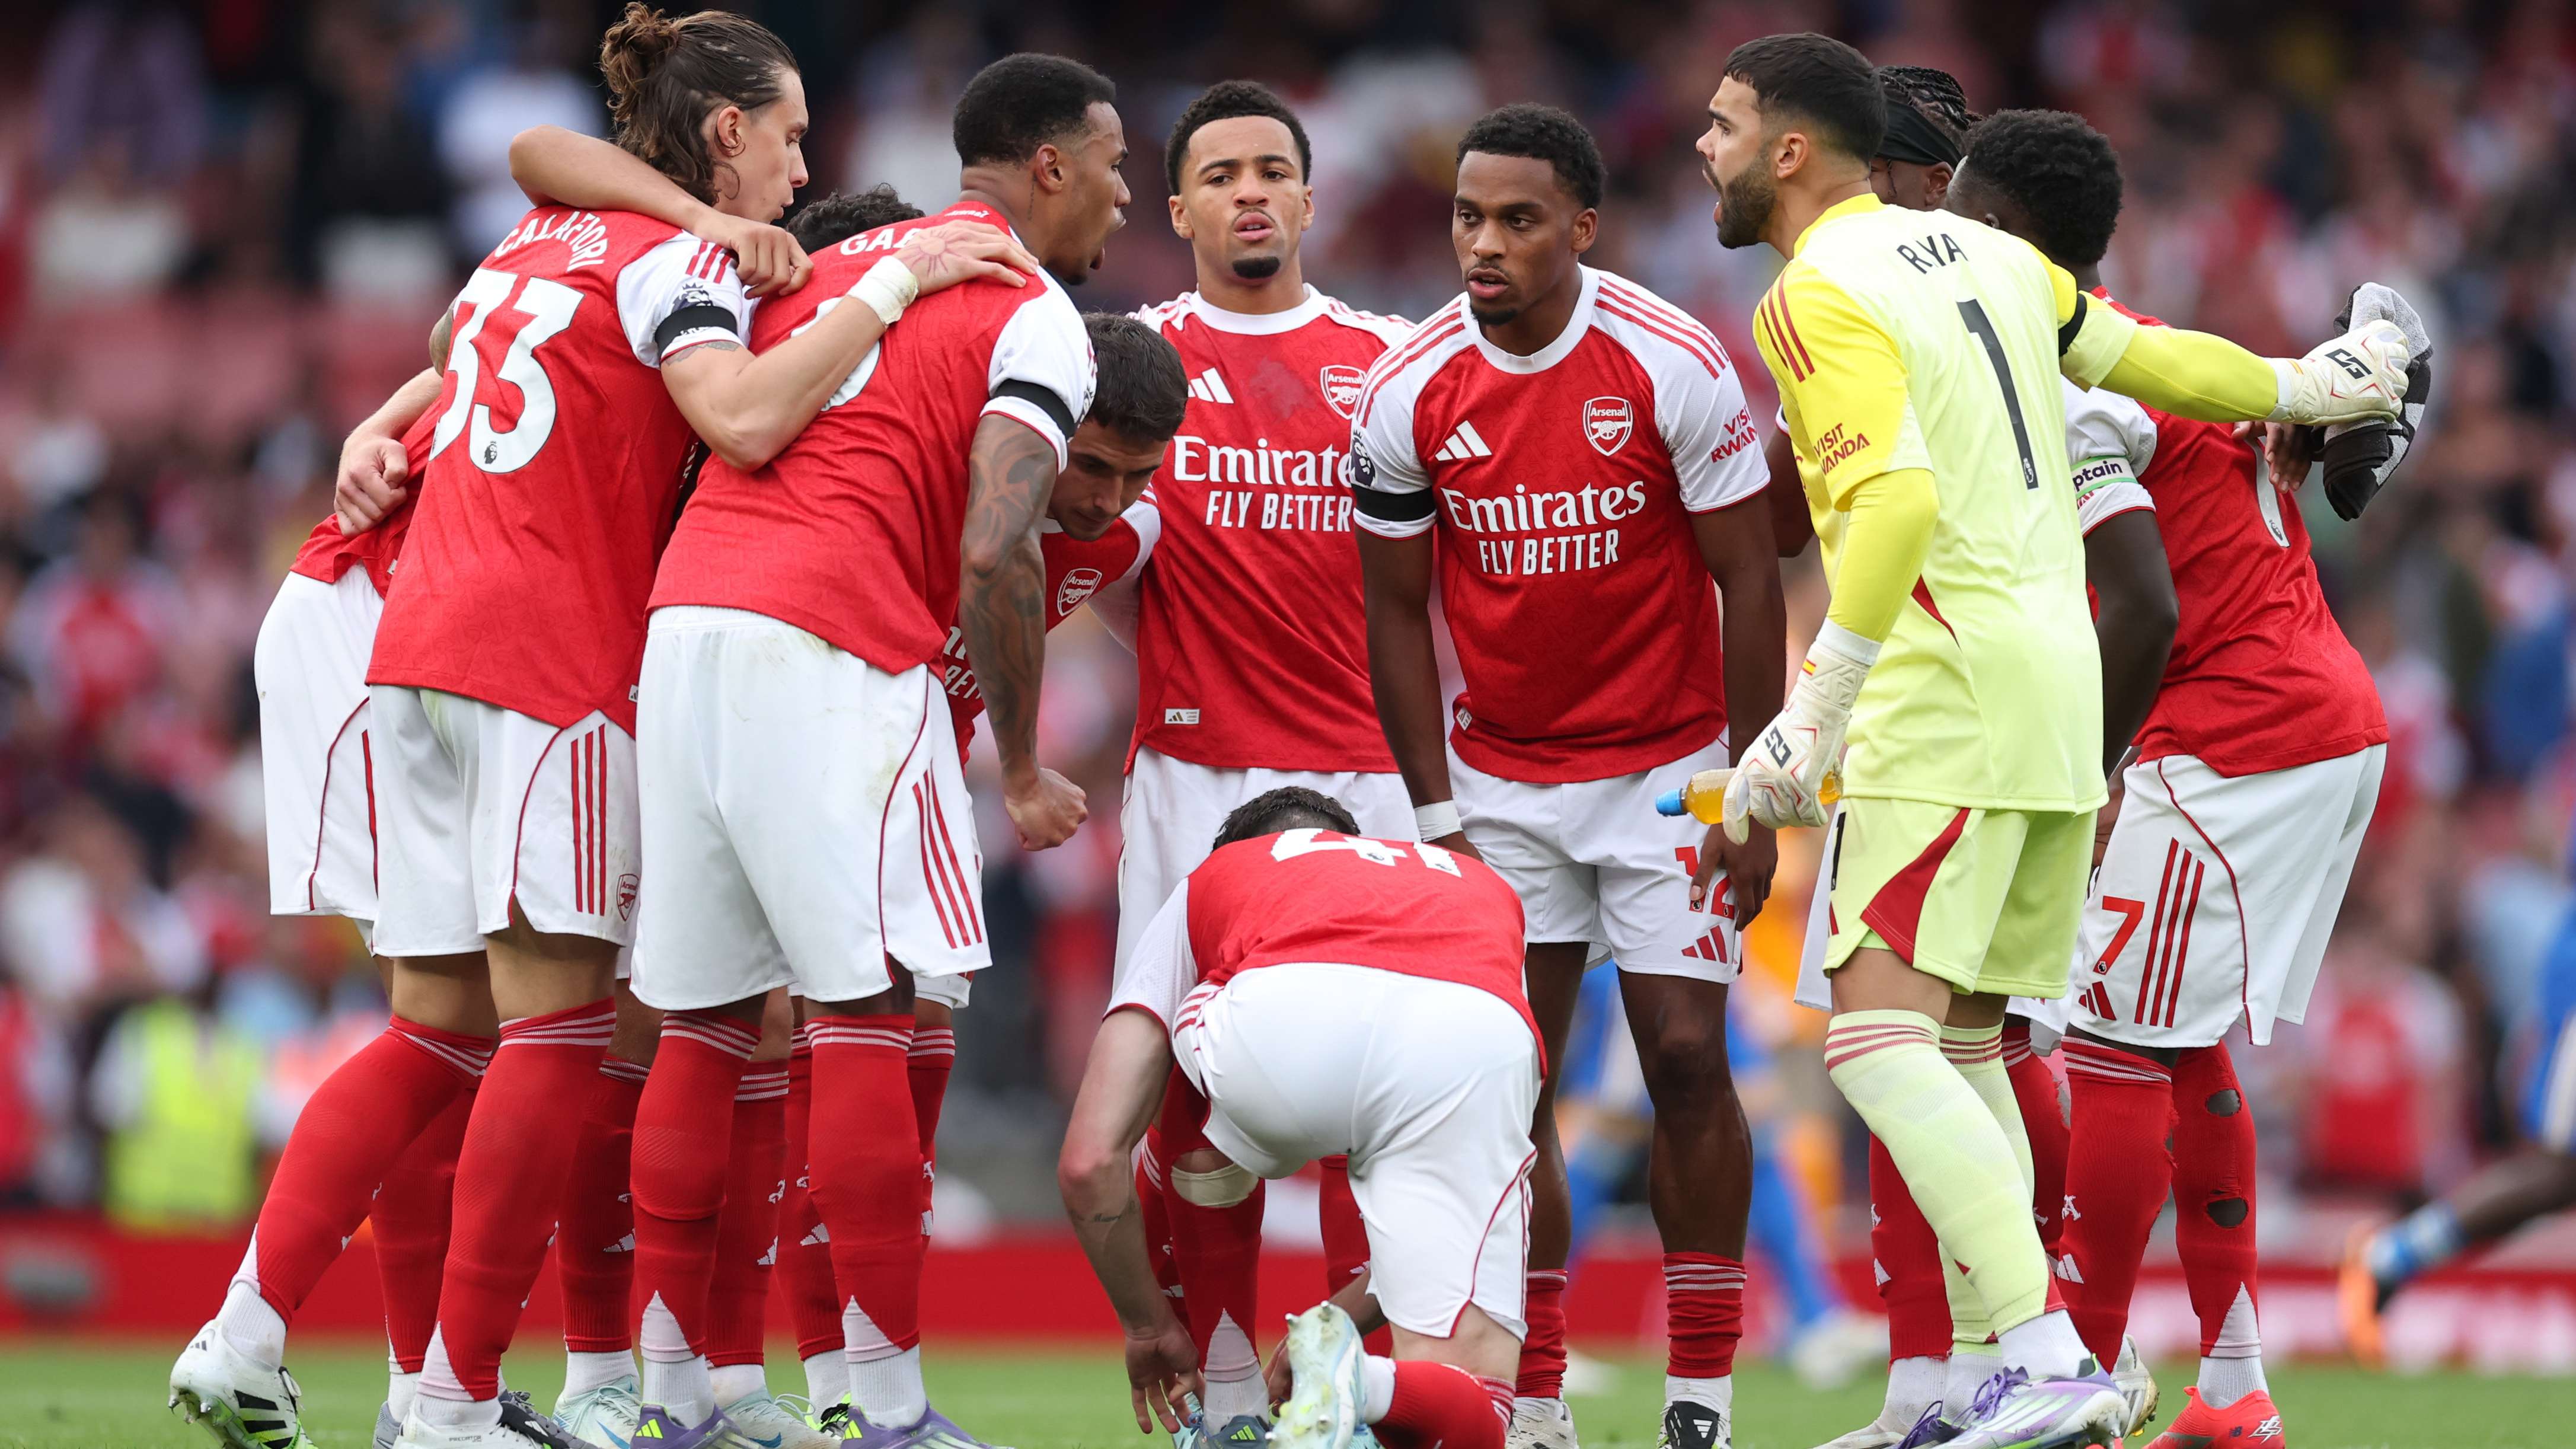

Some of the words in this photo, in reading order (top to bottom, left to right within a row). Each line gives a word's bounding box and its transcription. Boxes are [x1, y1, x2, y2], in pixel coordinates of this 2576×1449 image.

[494, 210, 608, 272] CALAFIORI
[428, 267, 585, 474] 33
[1327, 374, 1362, 384] Arsenal
[1956, 298, 2039, 490] 1
[1590, 407, 1626, 416] Arsenal
[1173, 435, 1352, 488] Emirate
[2072, 460, 2122, 492] ptain
[1205, 491, 1253, 528] FLY
[1260, 493, 1352, 532] BETTER
[1440, 480, 1646, 533] Emirates
[1478, 540, 1514, 576] FLY
[1522, 528, 1620, 576] BETTER
[1068, 576, 1097, 586] Arsenal
[2093, 895, 2145, 975] 7
